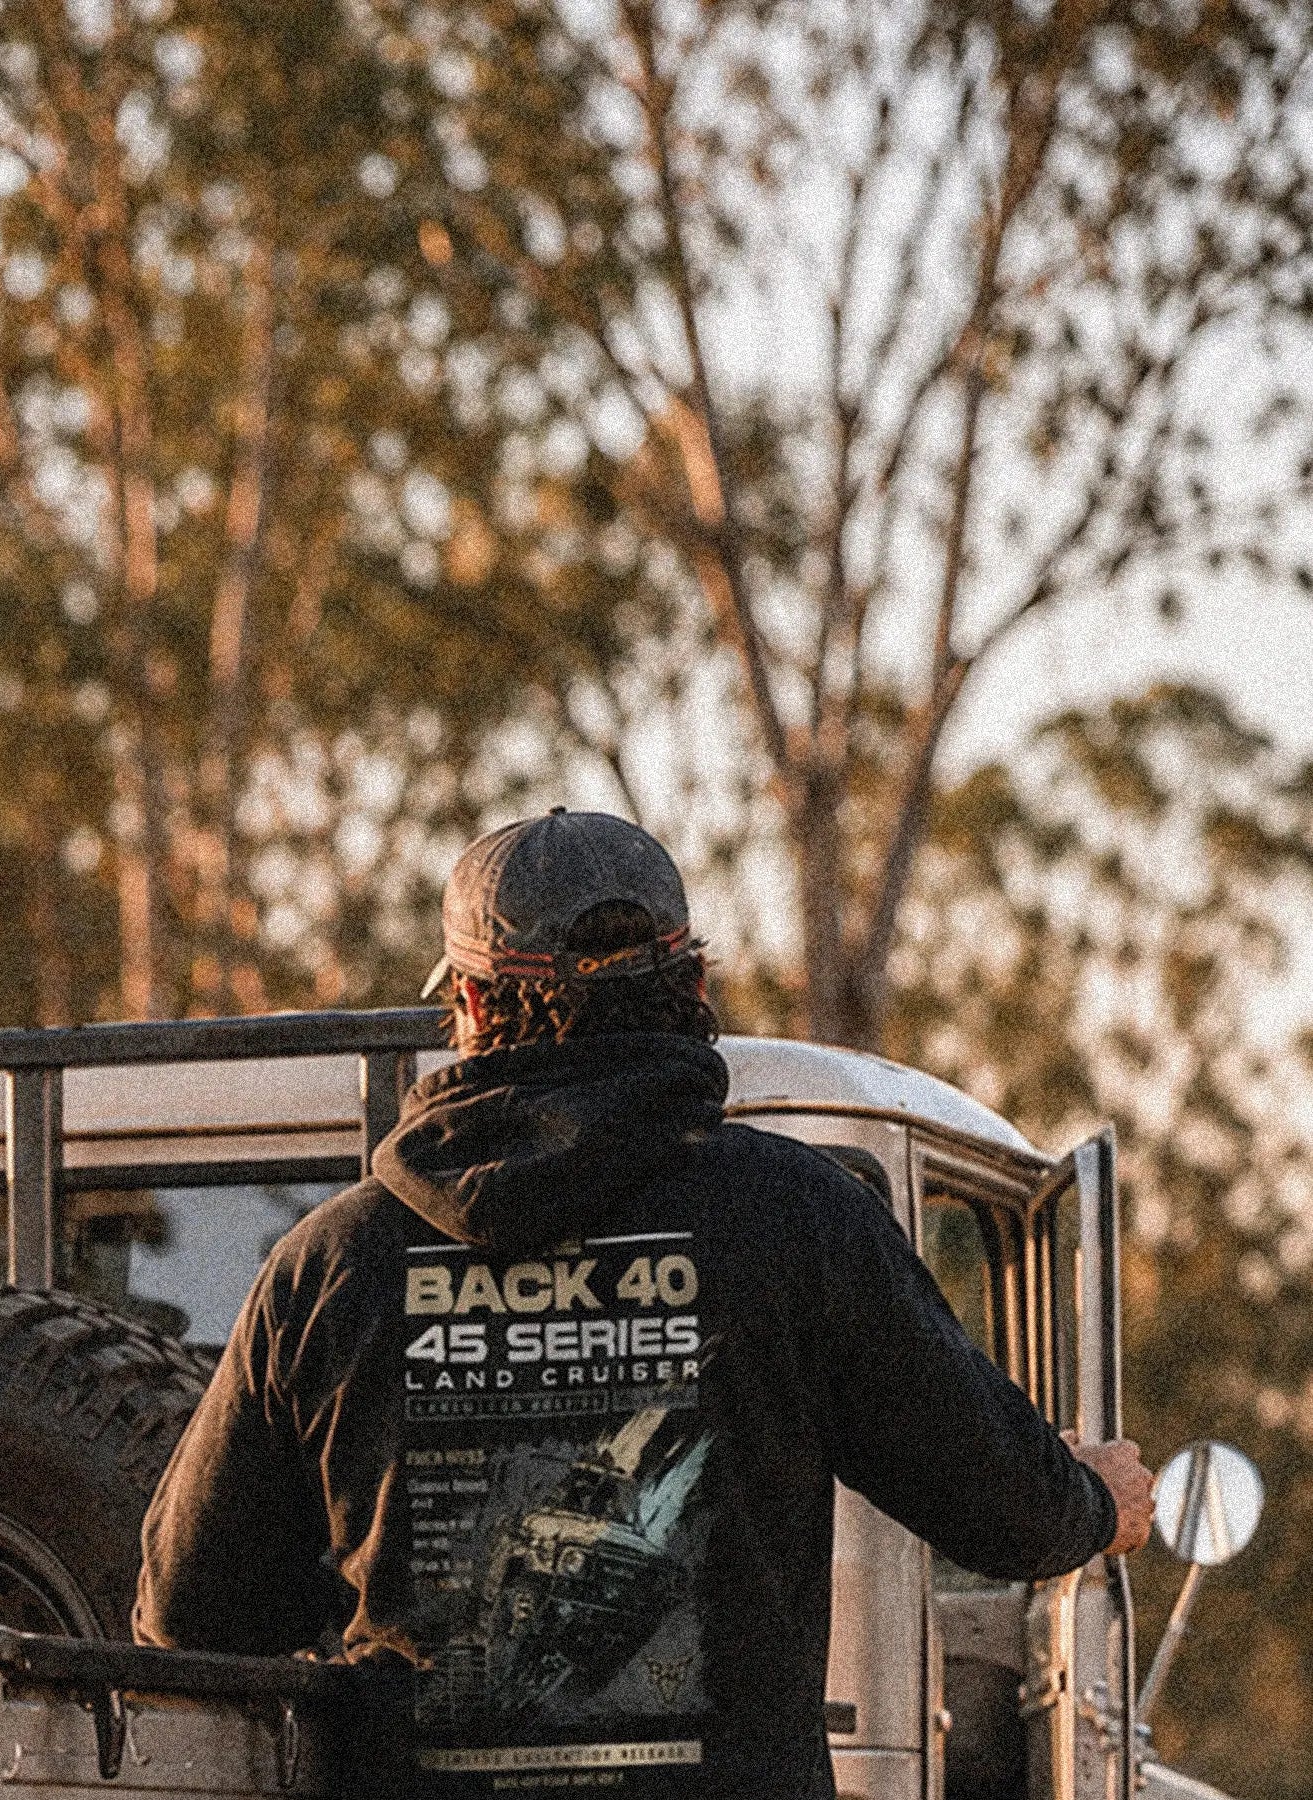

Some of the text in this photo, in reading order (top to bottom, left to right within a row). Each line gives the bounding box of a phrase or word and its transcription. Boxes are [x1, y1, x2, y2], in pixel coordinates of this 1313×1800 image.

[405, 1254, 700, 1315] BACK 40
[405, 1315, 701, 1364] 45 SERIES
[405, 1360, 701, 1391] LAND CRUISER
